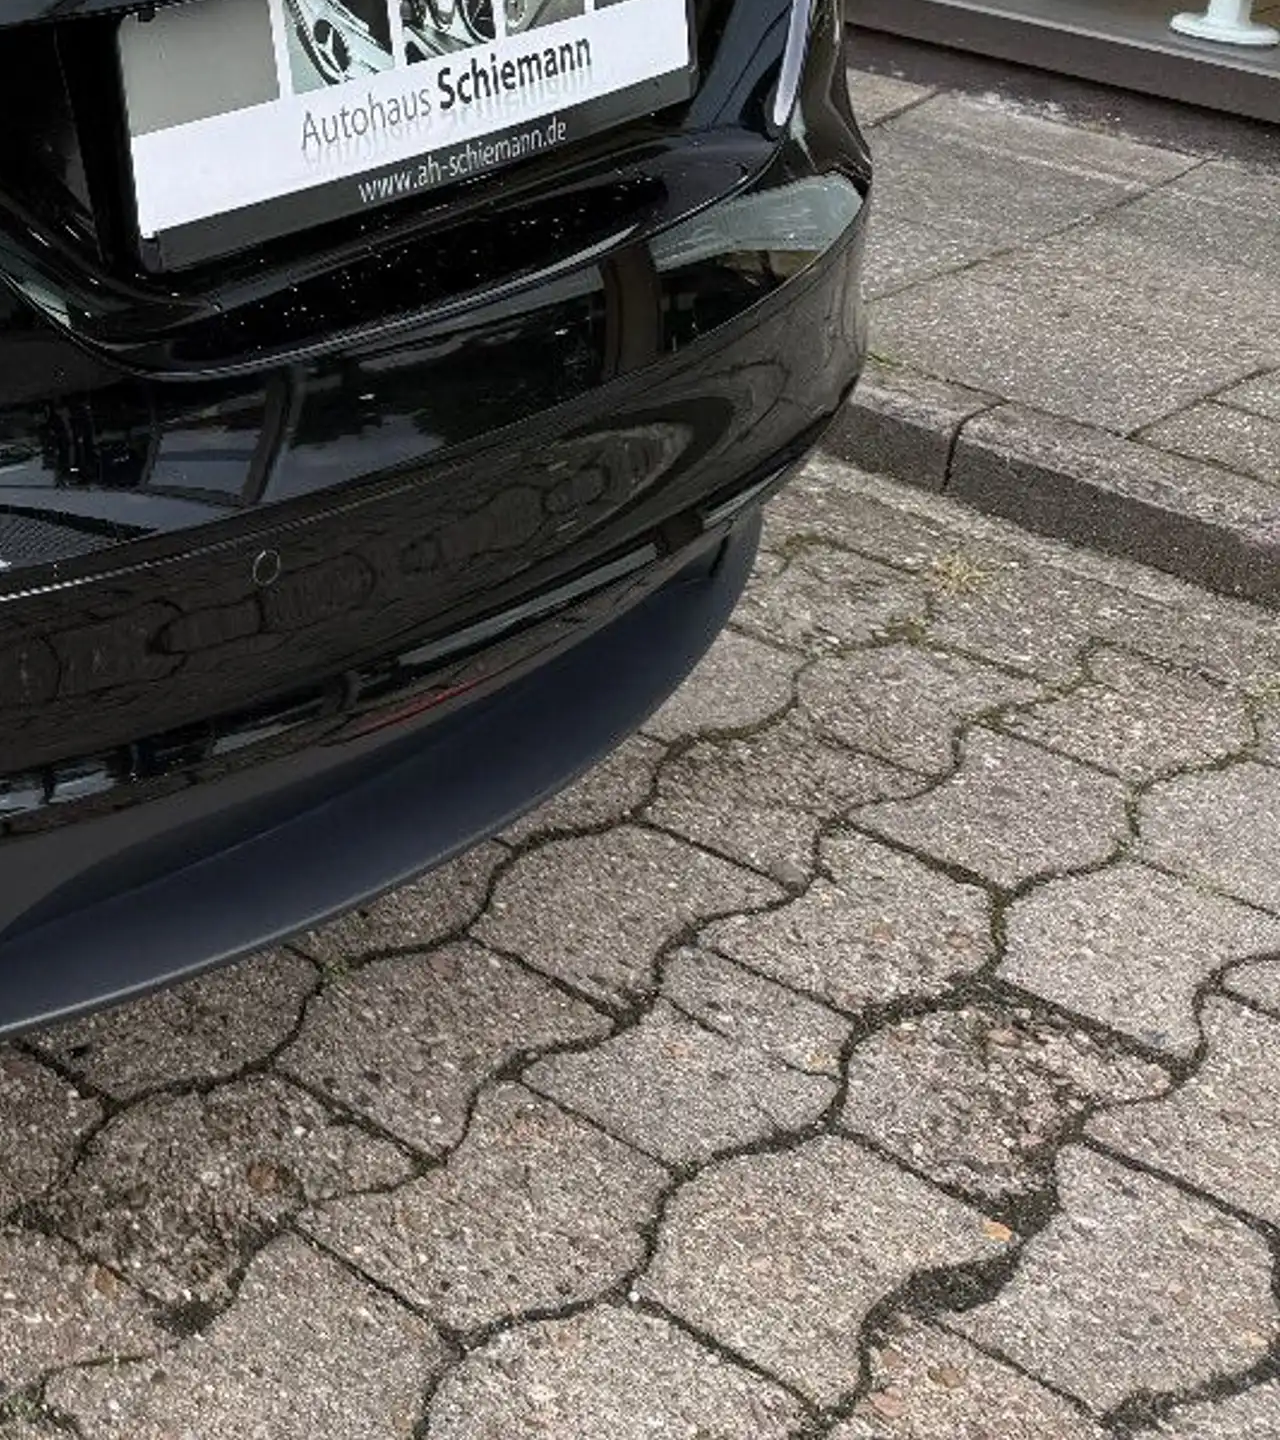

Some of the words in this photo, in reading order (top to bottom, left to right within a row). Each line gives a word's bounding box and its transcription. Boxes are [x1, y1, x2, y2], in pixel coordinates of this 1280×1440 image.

[301, 85, 432, 150] Autohaus
[438, 37, 591, 109] Schiemann
[357, 118, 567, 203] www.ah-schiemann.de
